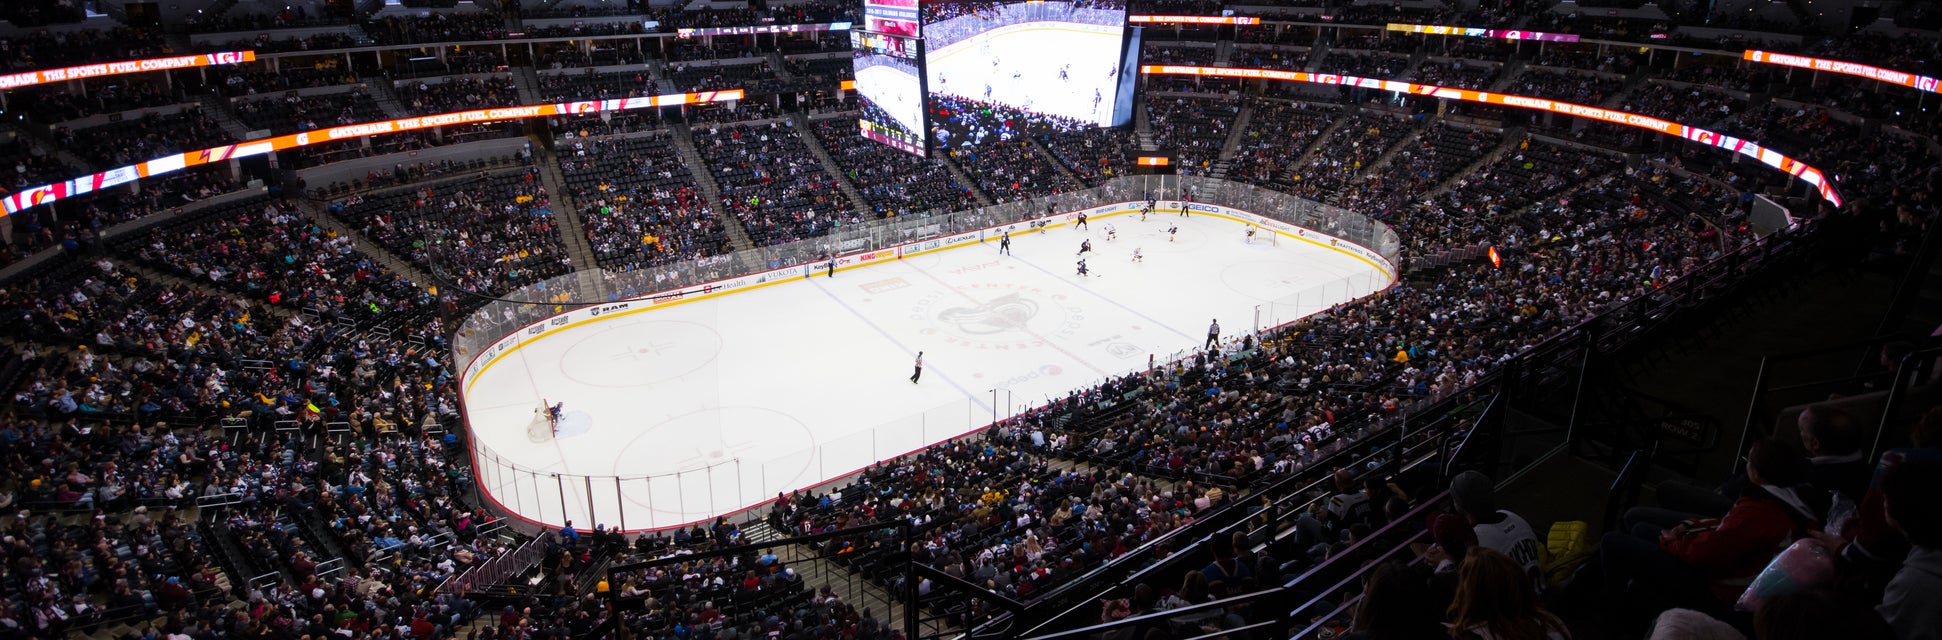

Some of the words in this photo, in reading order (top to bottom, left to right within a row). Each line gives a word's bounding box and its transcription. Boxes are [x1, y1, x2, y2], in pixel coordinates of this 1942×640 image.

[43, 70, 66, 82] THE
[67, 64, 107, 80] SPORTS
[108, 61, 140, 74] FUEL
[141, 56, 197, 71] COMPANY
[1162, 66, 1200, 75] GATORADE
[1202, 68, 1216, 76] THE
[1217, 68, 1242, 77] SPORTS
[1244, 70, 1261, 78] FUEL
[1262, 70, 1298, 80] COMPANY
[1752, 50, 1763, 62] G
[1769, 54, 1812, 68] GATORADE
[1815, 60, 1832, 70] THE
[1833, 62, 1862, 75] SPORTS
[1862, 67, 1876, 78] FUEL
[1878, 70, 1909, 84] COMPANY
[1504, 96, 1551, 110] GATORADE
[1554, 103, 1570, 113] THE
[1572, 106, 1604, 119] SPORTS
[1604, 110, 1628, 122] FUEL
[1628, 114, 1671, 131] COMPANY
[296, 132, 308, 146] G
[329, 121, 392, 140] GATORADE
[397, 118, 420, 130] THE
[421, 113, 460, 127] SPORTS
[462, 110, 488, 122] FUEL
[490, 106, 541, 120] COMPANY
[1188, 204, 1219, 213] GEICO
[953, 234, 976, 242] LEXUS
[1336, 242, 1363, 254] DRAFTKINGS
[860, 253, 875, 261] KING
[768, 268, 798, 279] VUKOTA
[602, 303, 629, 312] RAM
[1662, 422, 1689, 436] ROW
